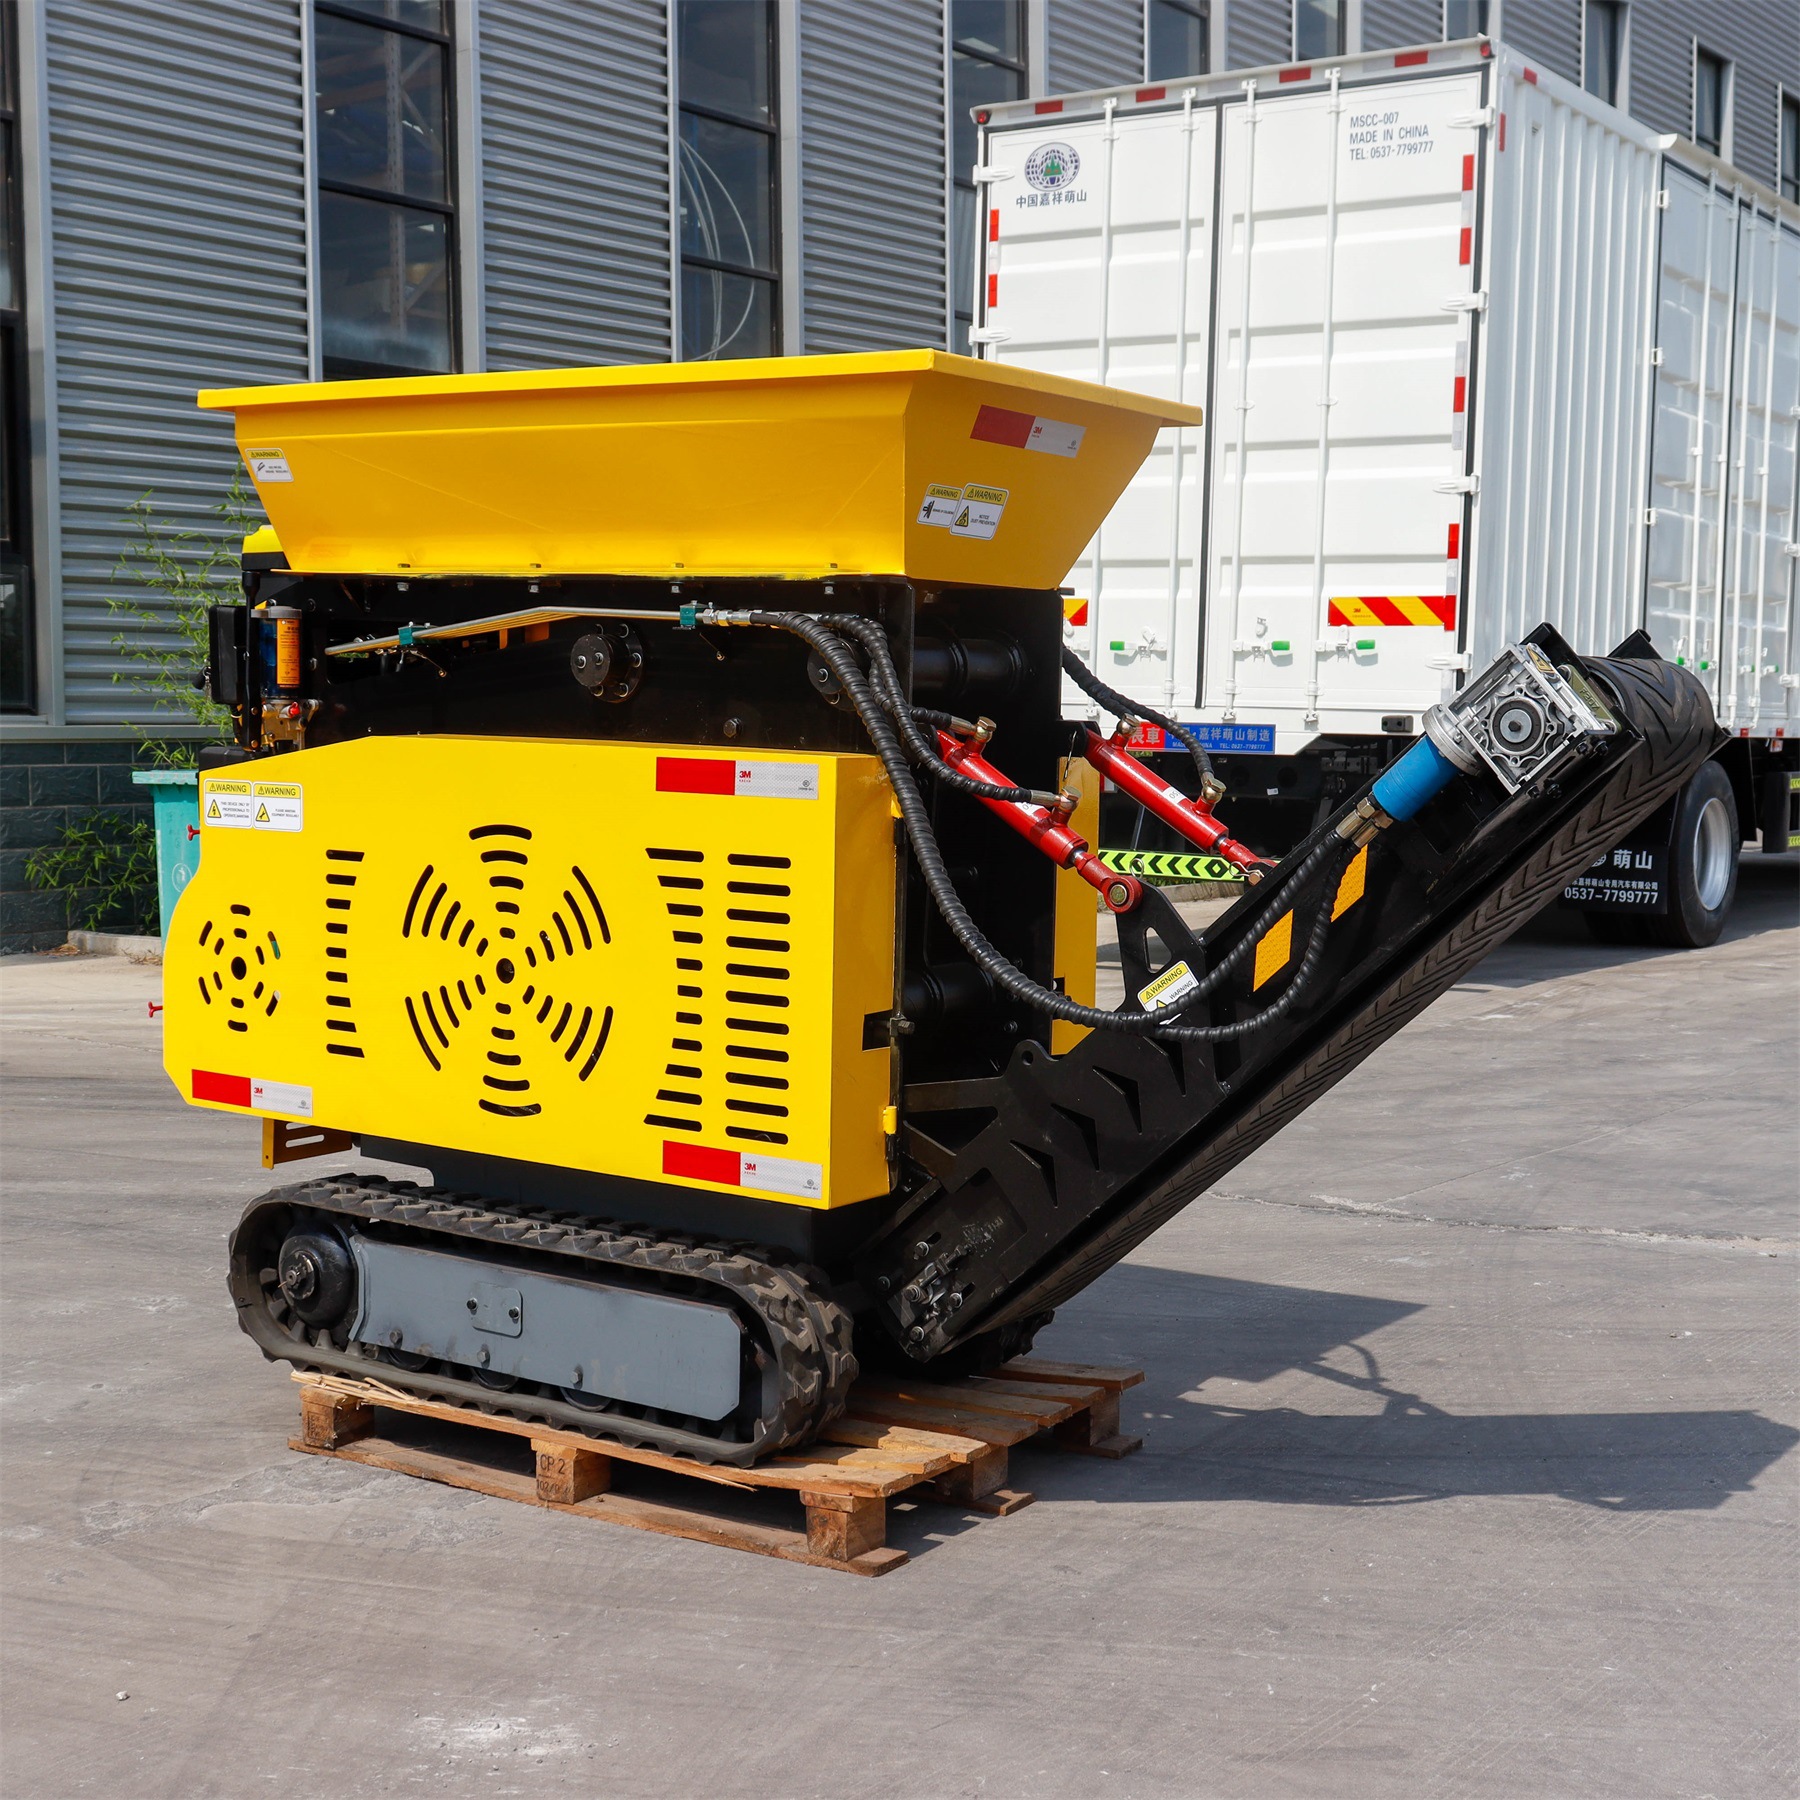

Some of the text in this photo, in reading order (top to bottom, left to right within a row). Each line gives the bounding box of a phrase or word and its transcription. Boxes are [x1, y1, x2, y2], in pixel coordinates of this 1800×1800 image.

[1350, 111, 1399, 128] MSCC-007
[1349, 124, 1430, 145] MADE IN CHINA
[1016, 189, 1087, 208] 中国嘉祥萌山
[1033, 426, 1043, 435] 3M
[935, 488, 959, 499] WARNING
[974, 489, 1003, 502] WARNING
[1168, 726, 1270, 742] ·嘉祥萌山制造
[739, 770, 752, 779] 3M
[215, 783, 247, 793] WARNING
[264, 787, 296, 796] WARNING
[1613, 849, 1653, 869] 萌山
[1564, 886, 1658, 904] 0537-7799777
[1150, 967, 1183, 994] WARNING
[1168, 980, 1193, 1000] WARNING
[253, 1086, 263, 1094] 3M
[744, 1162, 756, 1171] 3M
